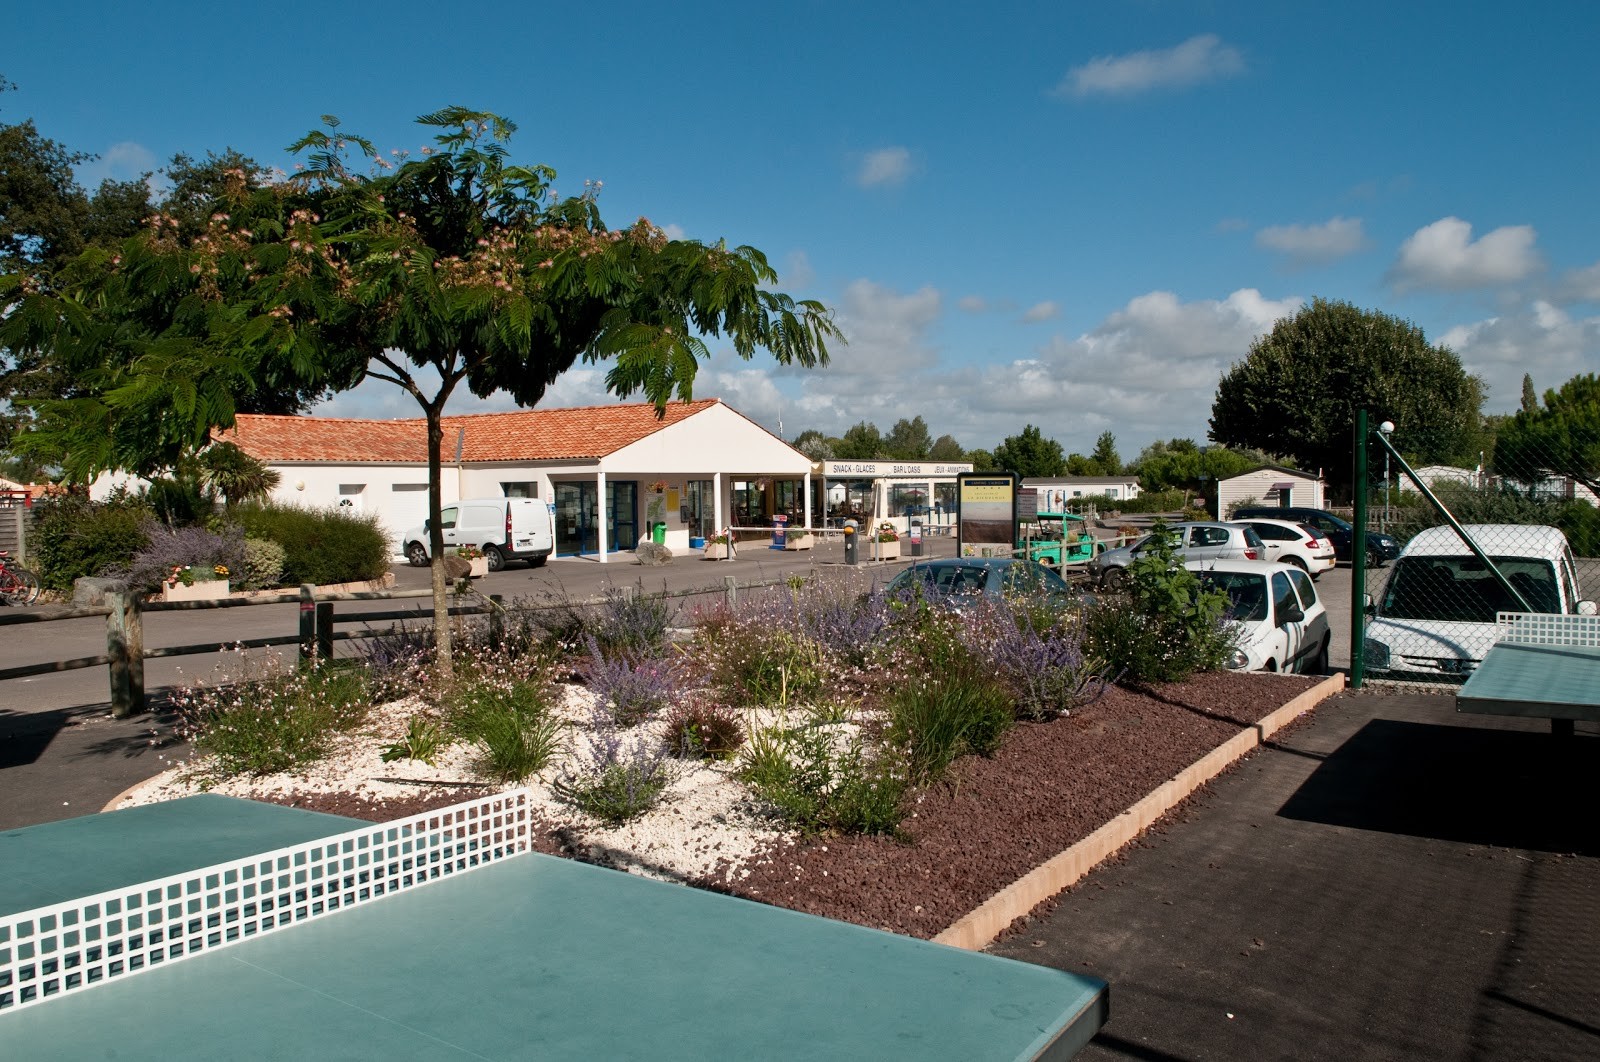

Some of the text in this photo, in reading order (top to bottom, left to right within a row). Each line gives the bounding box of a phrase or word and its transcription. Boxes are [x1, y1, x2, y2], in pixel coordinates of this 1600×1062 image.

[833, 464, 852, 473] SNACK
[855, 464, 876, 473] GLACES
[893, 465, 904, 474] BAR
[934, 466, 945, 474] JEUX
